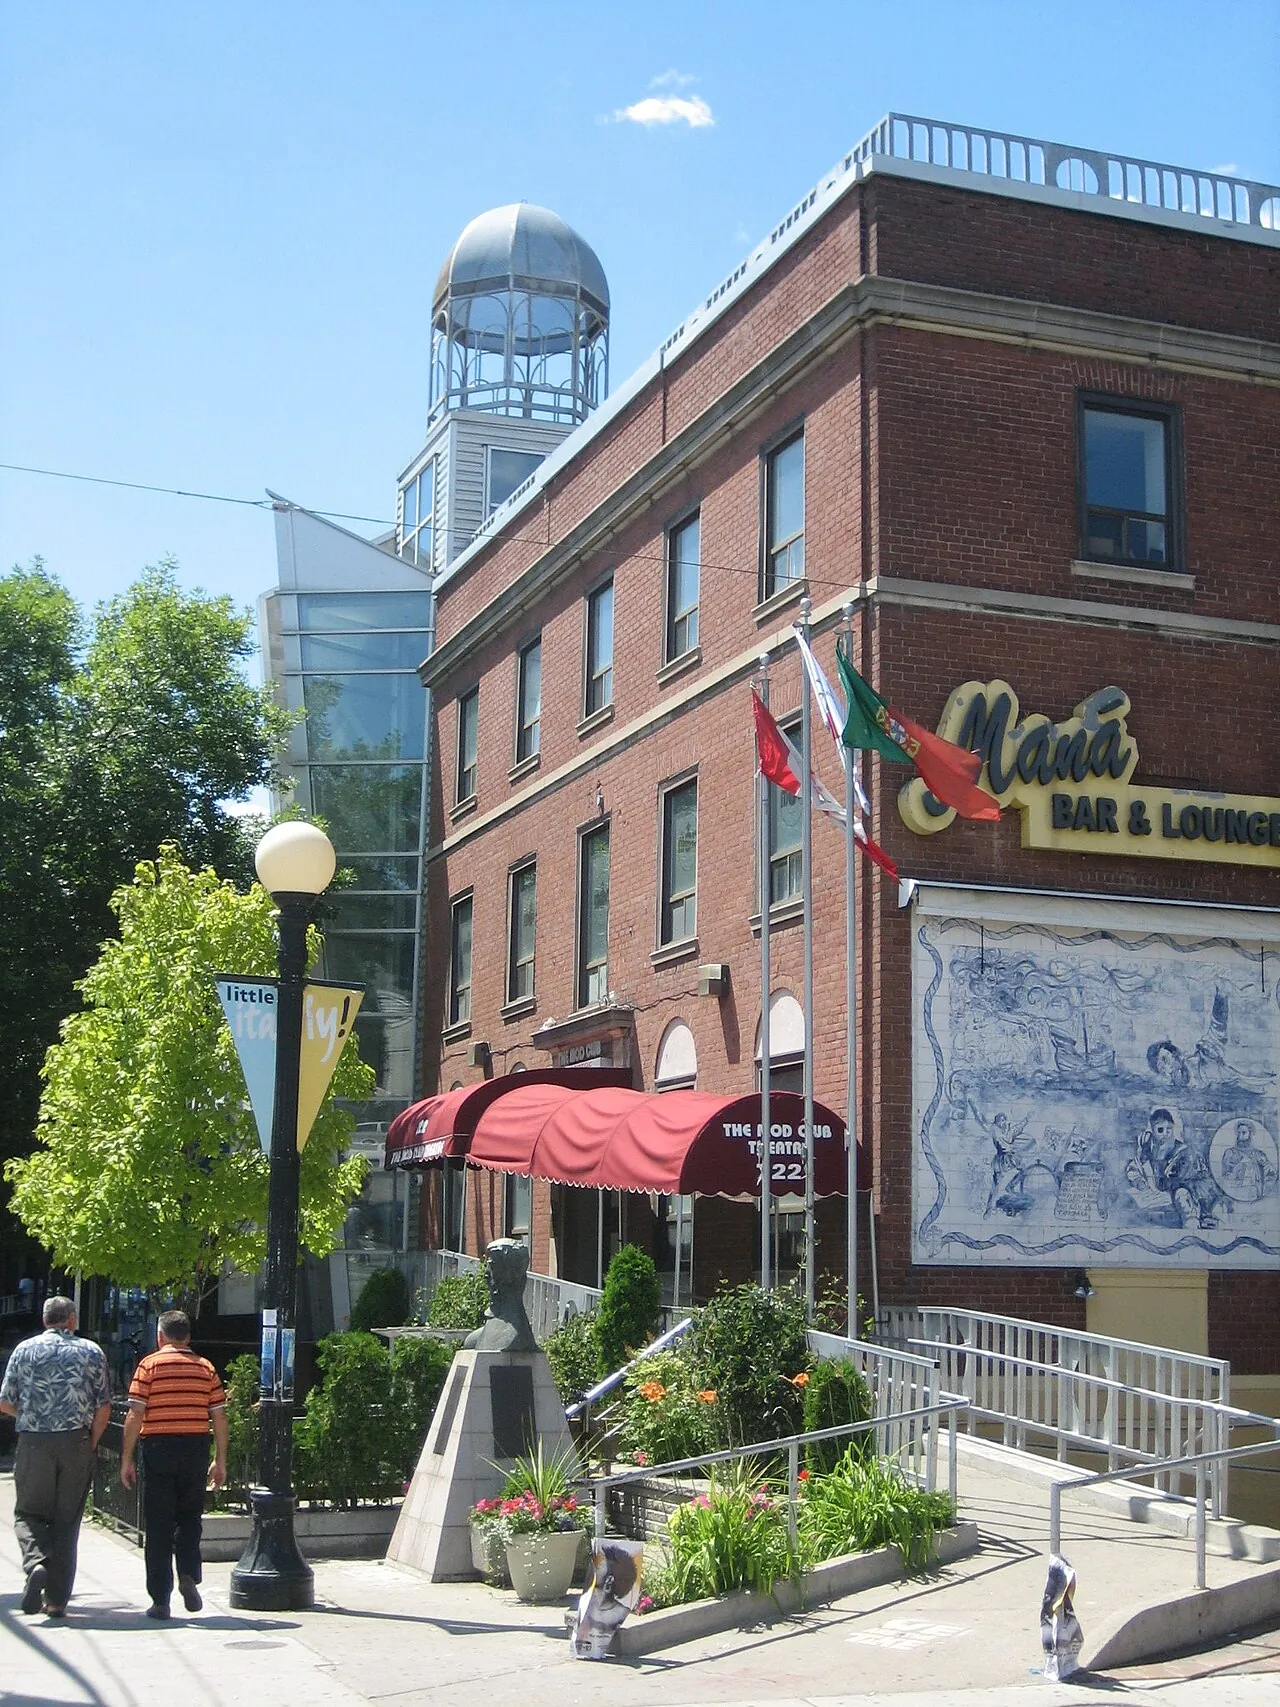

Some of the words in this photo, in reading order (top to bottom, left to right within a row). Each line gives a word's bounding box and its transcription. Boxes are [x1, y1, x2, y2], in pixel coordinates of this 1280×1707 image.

[1052, 793, 1119, 833] BAR
[1129, 800, 1152, 836] &
[1162, 802, 1280, 847] LOUNGE
[226, 985, 274, 1005] little
[722, 1123, 752, 1137] THE
[797, 1124, 832, 1138] CUB
[748, 1140, 811, 1155] TEATR
